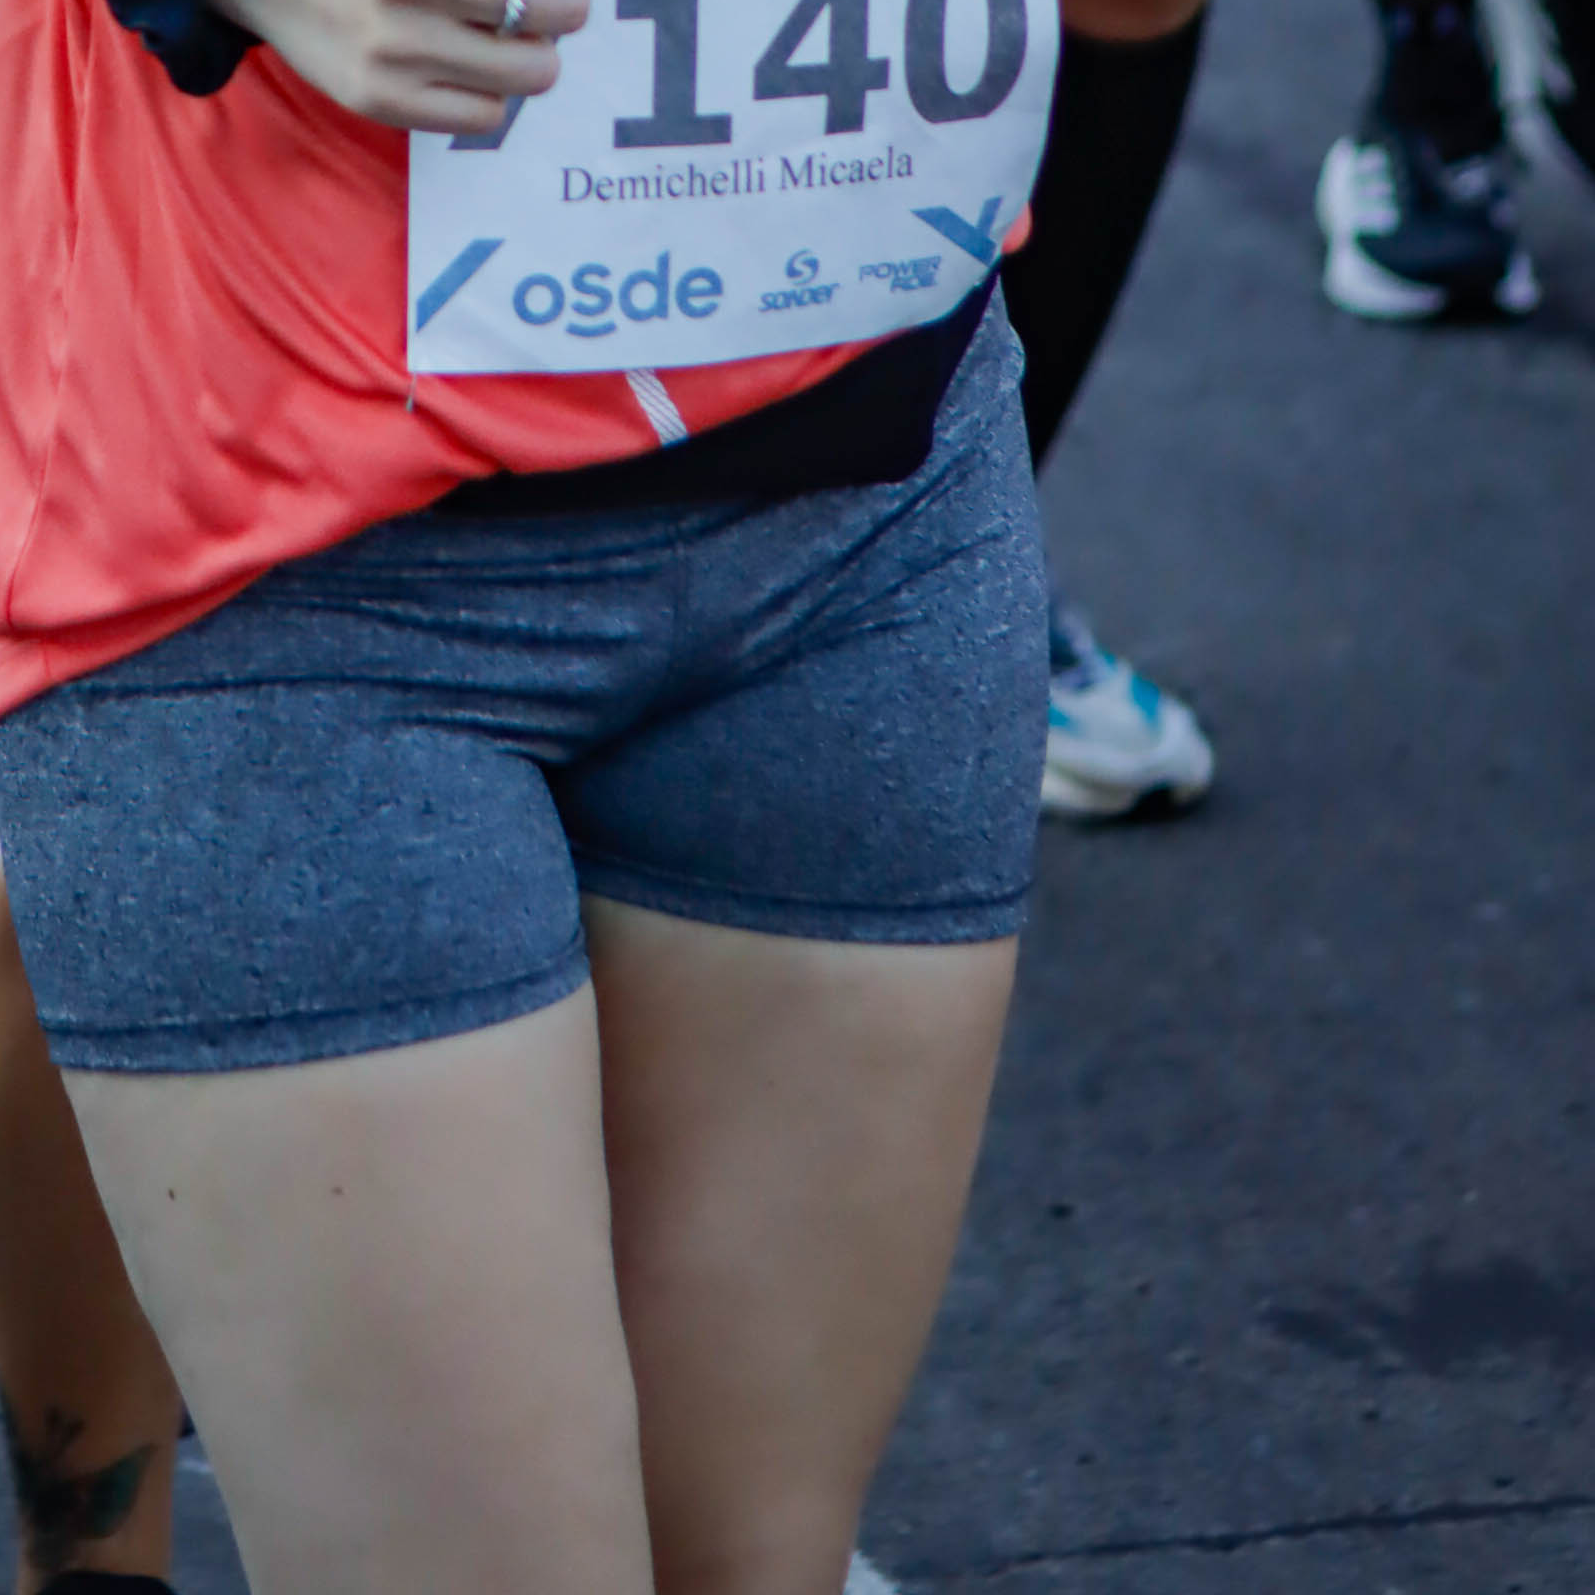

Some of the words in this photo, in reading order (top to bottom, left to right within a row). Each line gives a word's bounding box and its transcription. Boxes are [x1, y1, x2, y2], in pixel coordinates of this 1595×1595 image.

[560, 156, 766, 202] Demichelli
[779, 145, 914, 190] Micaela
[511, 249, 725, 326] osde
[859, 256, 942, 282] POWER
